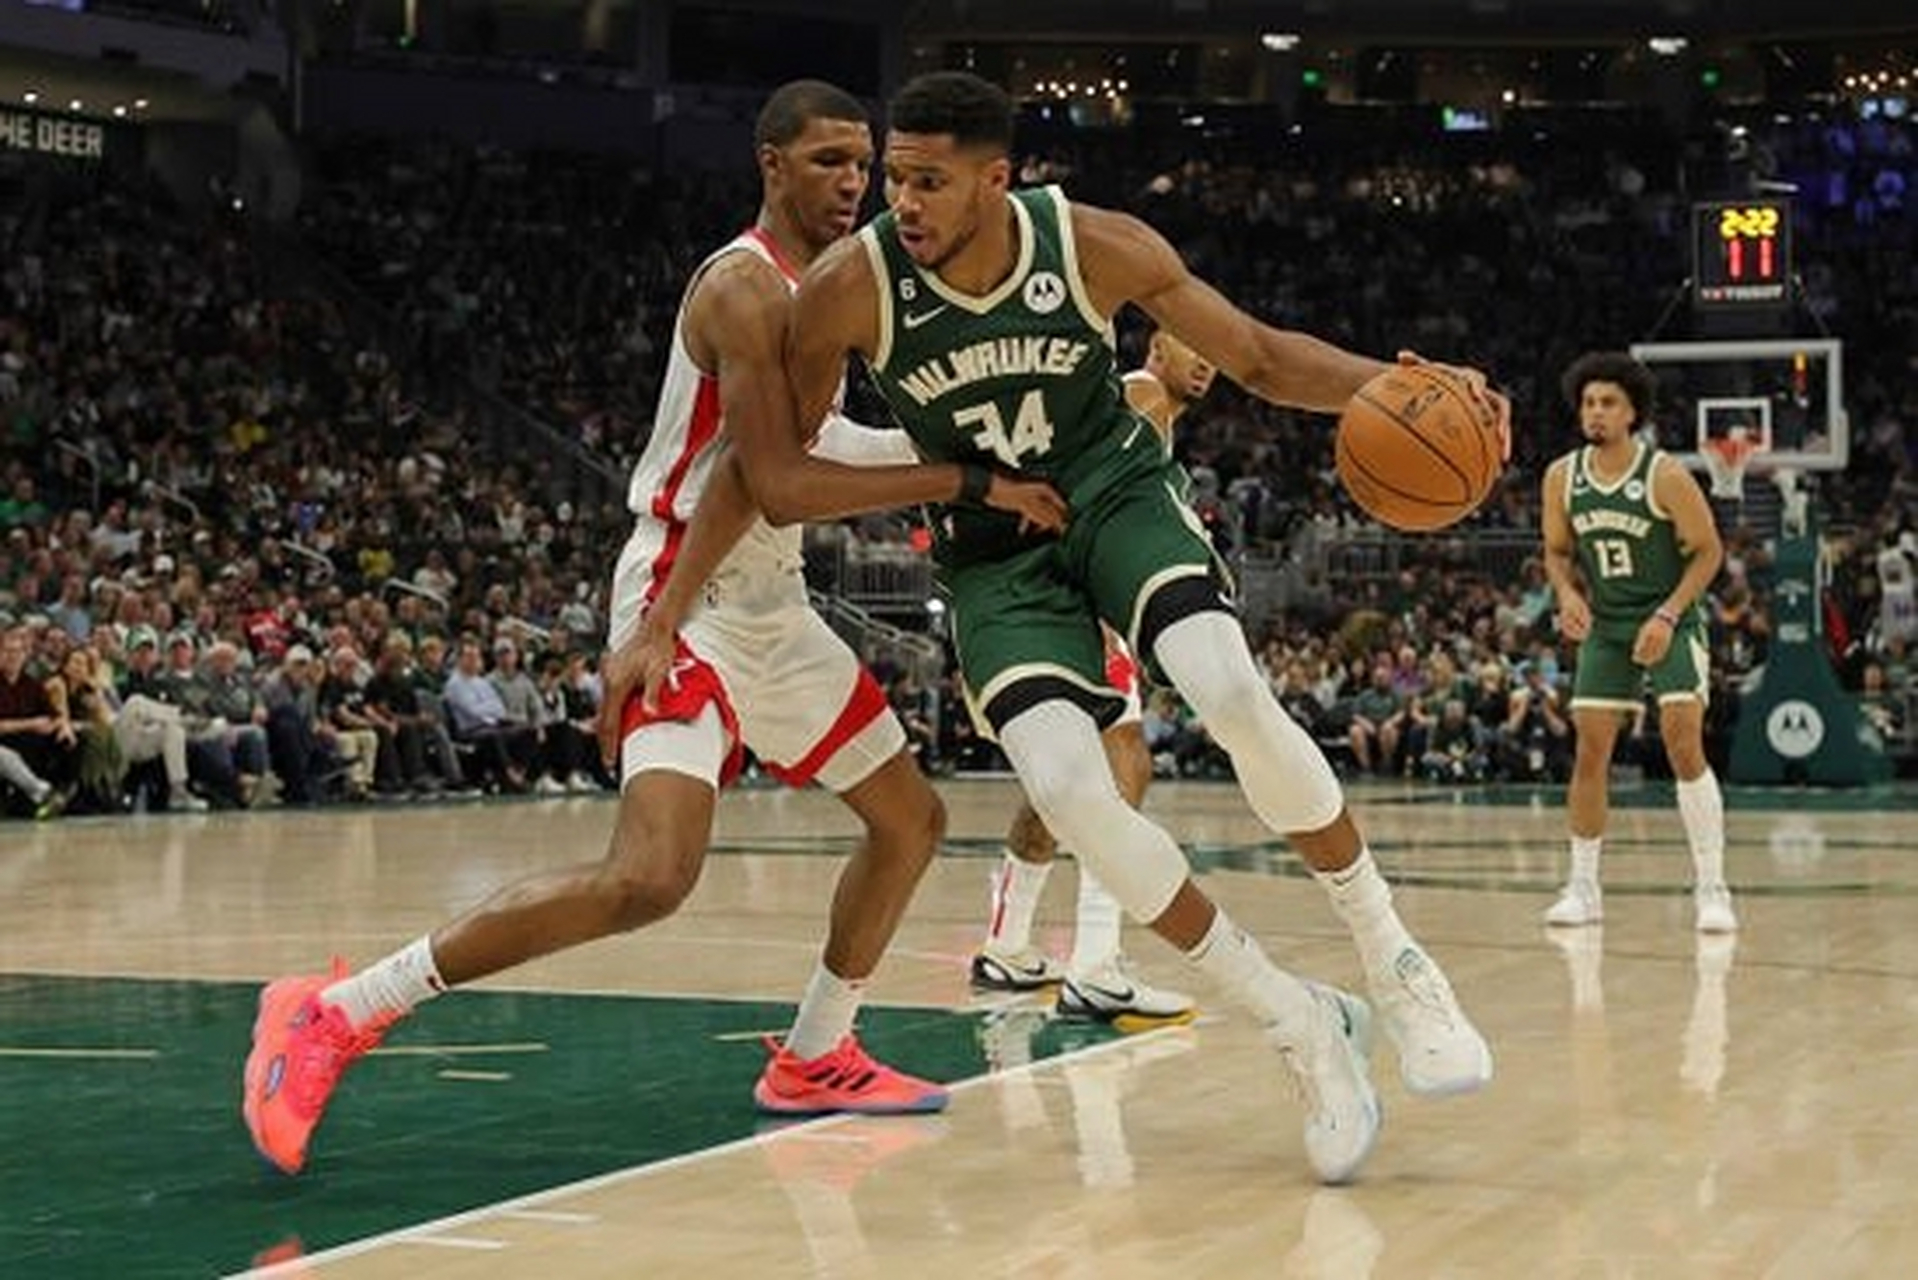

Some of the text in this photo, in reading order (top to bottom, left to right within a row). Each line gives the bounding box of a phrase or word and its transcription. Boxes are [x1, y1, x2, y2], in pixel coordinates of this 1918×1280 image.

[37, 116, 102, 157] DEER
[1729, 239, 1771, 277] 11
[899, 278, 916, 300] 6
[899, 337, 1089, 406] MILWAUKEE
[953, 389, 1054, 468] 34
[1595, 540, 1633, 577] 13
